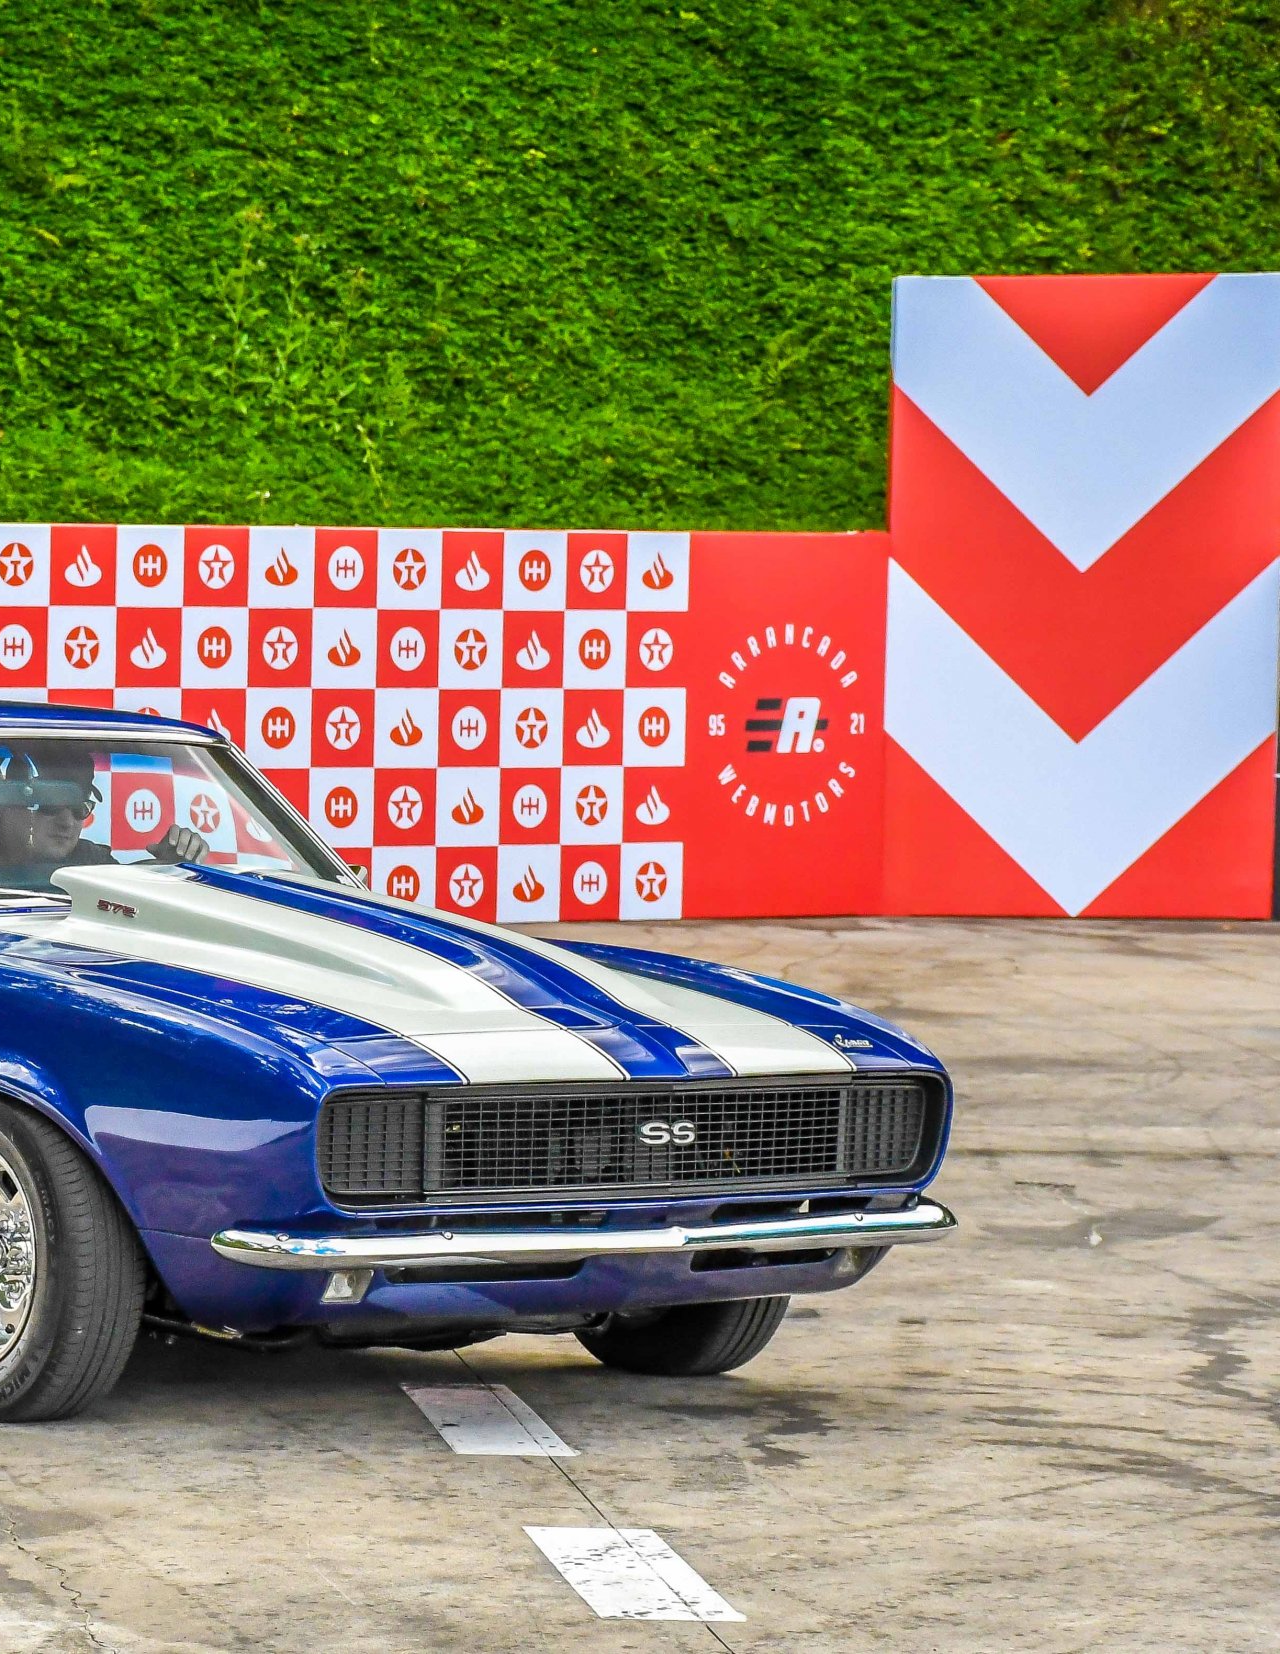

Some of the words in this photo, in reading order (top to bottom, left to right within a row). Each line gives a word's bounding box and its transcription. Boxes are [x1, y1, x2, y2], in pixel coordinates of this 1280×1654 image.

[718, 623, 858, 689] ARRANCADA
[708, 714, 726, 736] 95
[849, 712, 865, 735] 21
[718, 762, 856, 827] WEBMOTORS
[638, 1120, 696, 1147] SS
